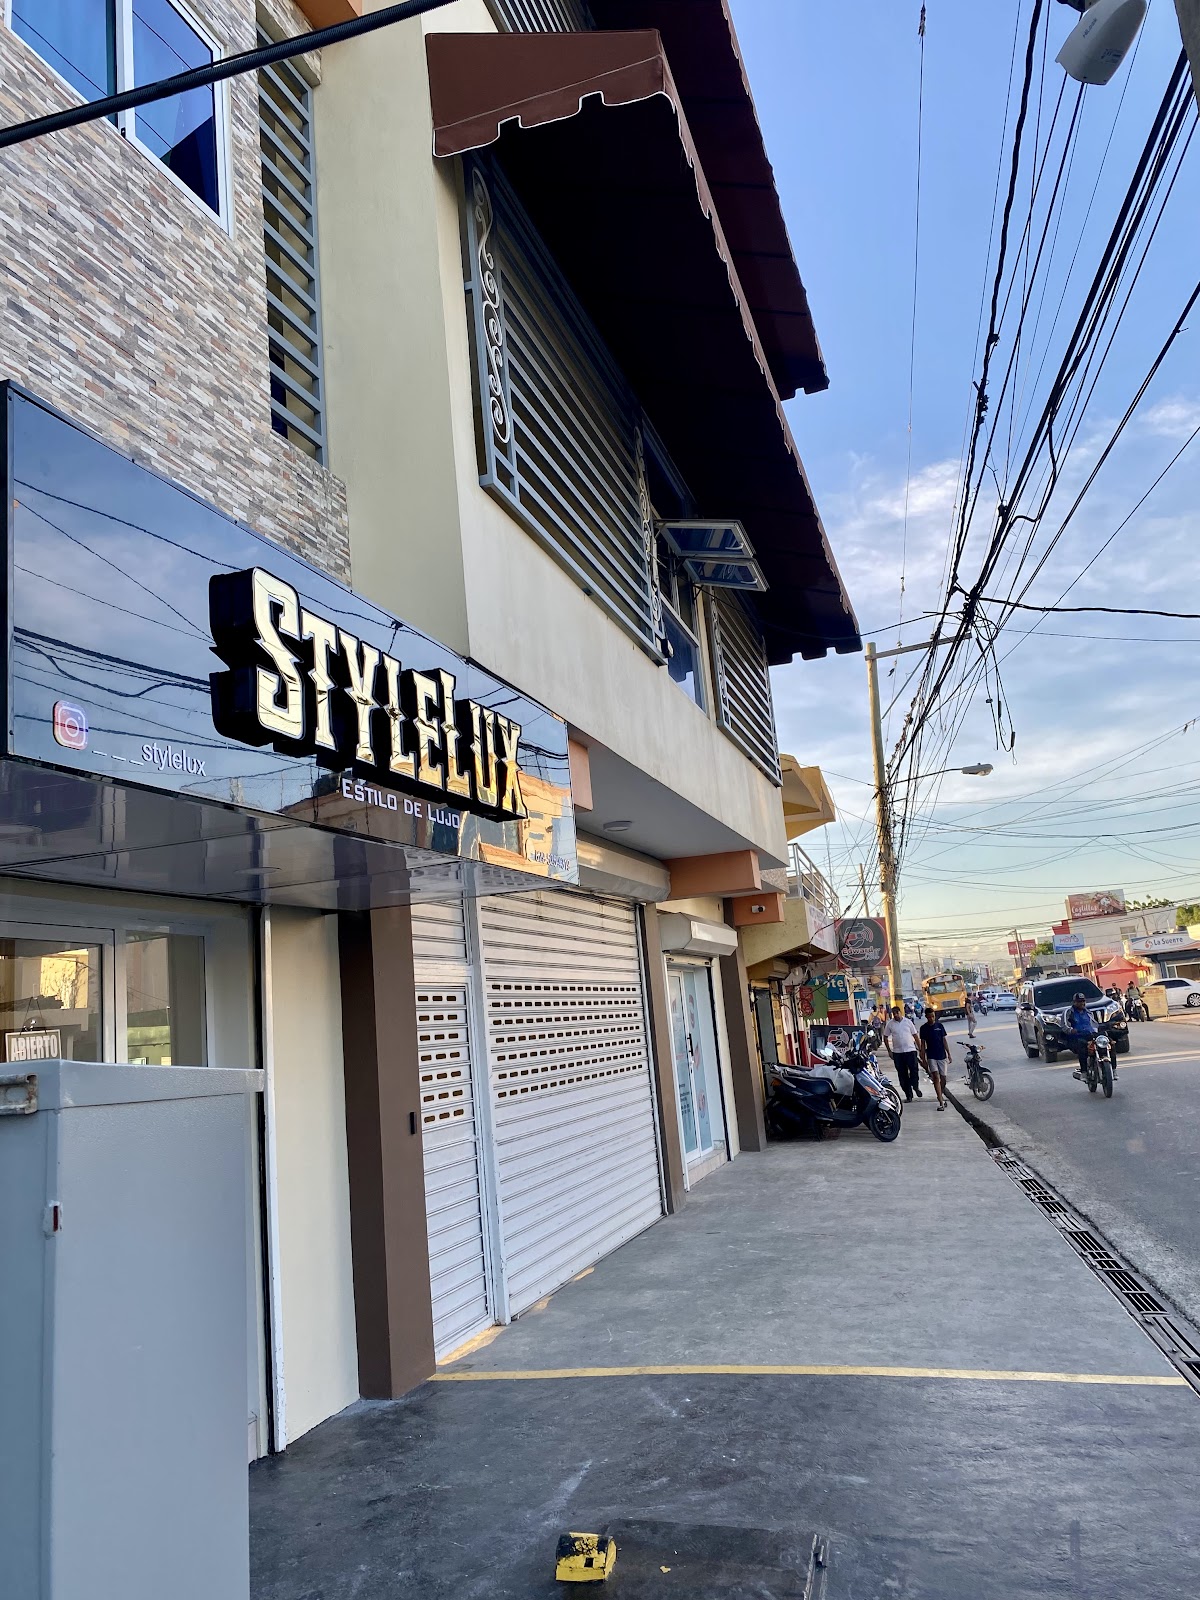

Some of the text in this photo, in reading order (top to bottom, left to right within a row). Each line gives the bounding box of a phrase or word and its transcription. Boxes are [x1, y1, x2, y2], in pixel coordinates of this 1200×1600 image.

[341, 778, 460, 829] ESTILO DE LUJO
[11, 1034, 58, 1062] ABIERTO
